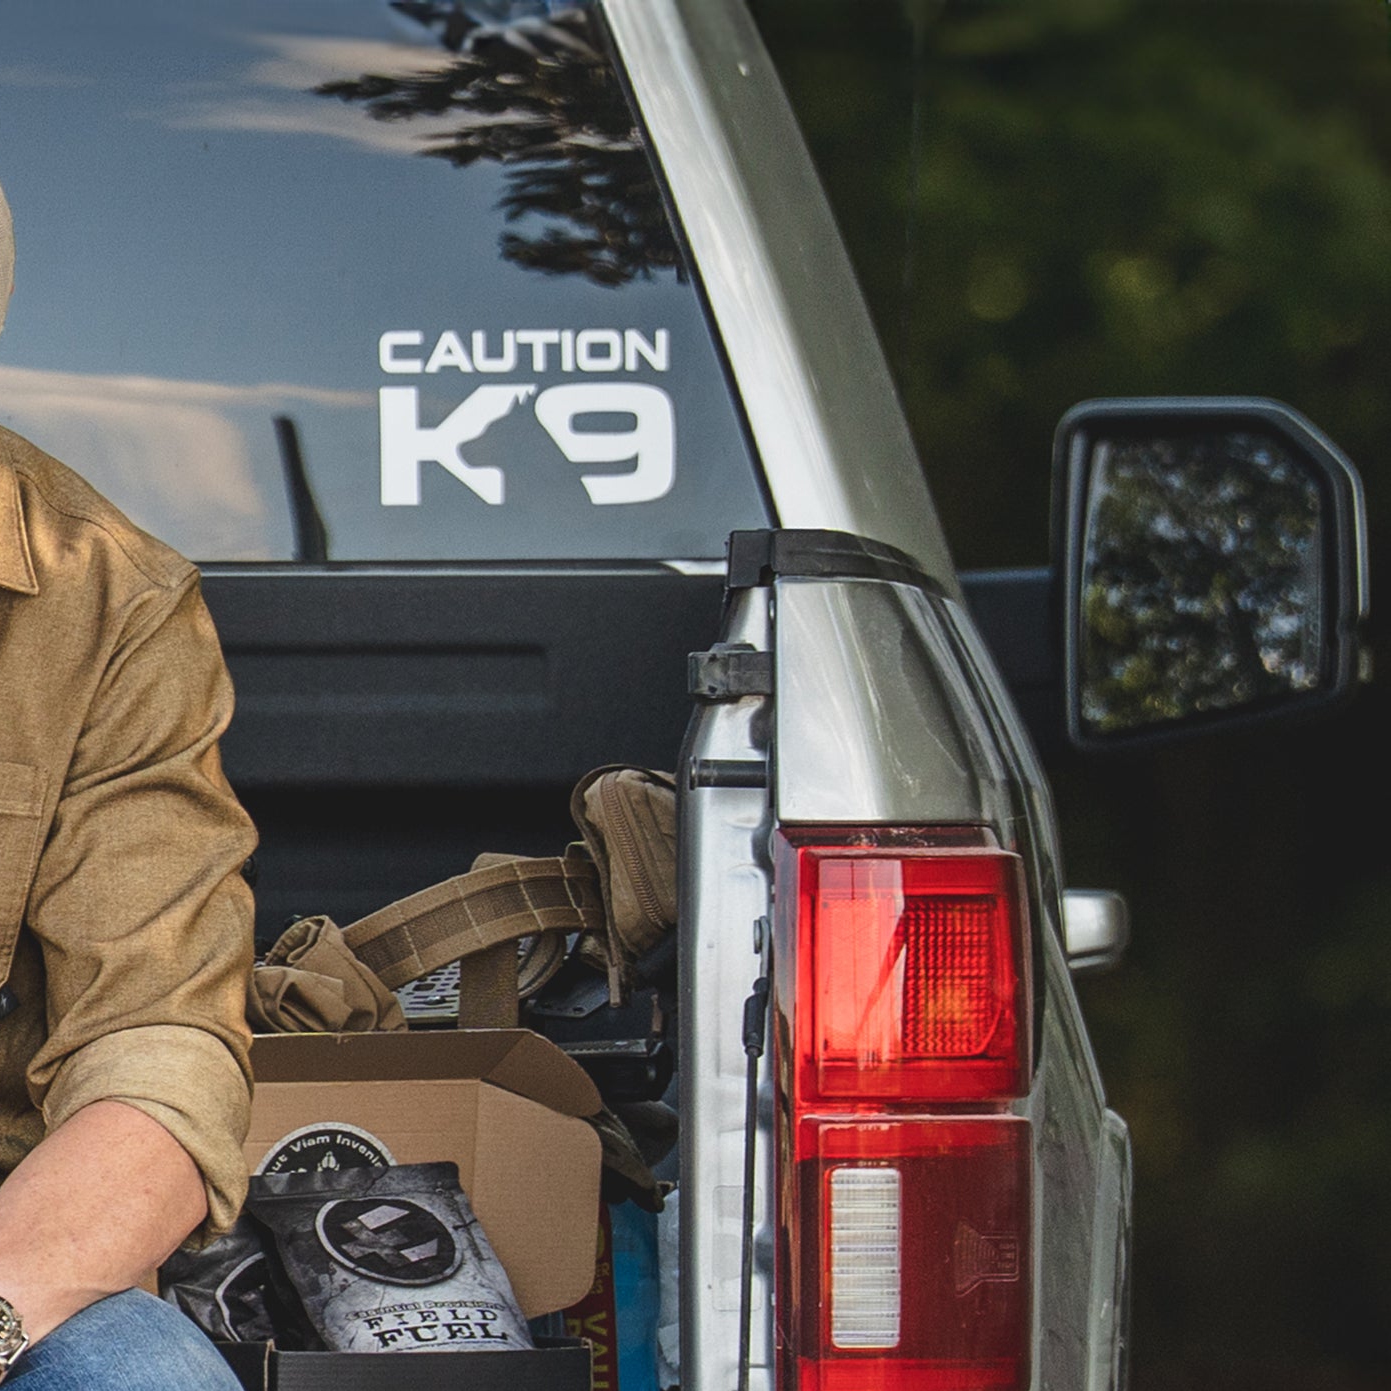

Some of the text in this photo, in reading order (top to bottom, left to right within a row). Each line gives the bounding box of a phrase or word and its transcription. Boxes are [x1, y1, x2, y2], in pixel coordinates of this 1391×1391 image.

[379, 328, 669, 374] CAUTION
[379, 381, 676, 506] K9
[289, 1134, 330, 1152] Viam
[363, 1309, 499, 1330] FIELD
[372, 1322, 508, 1348] FUEL
